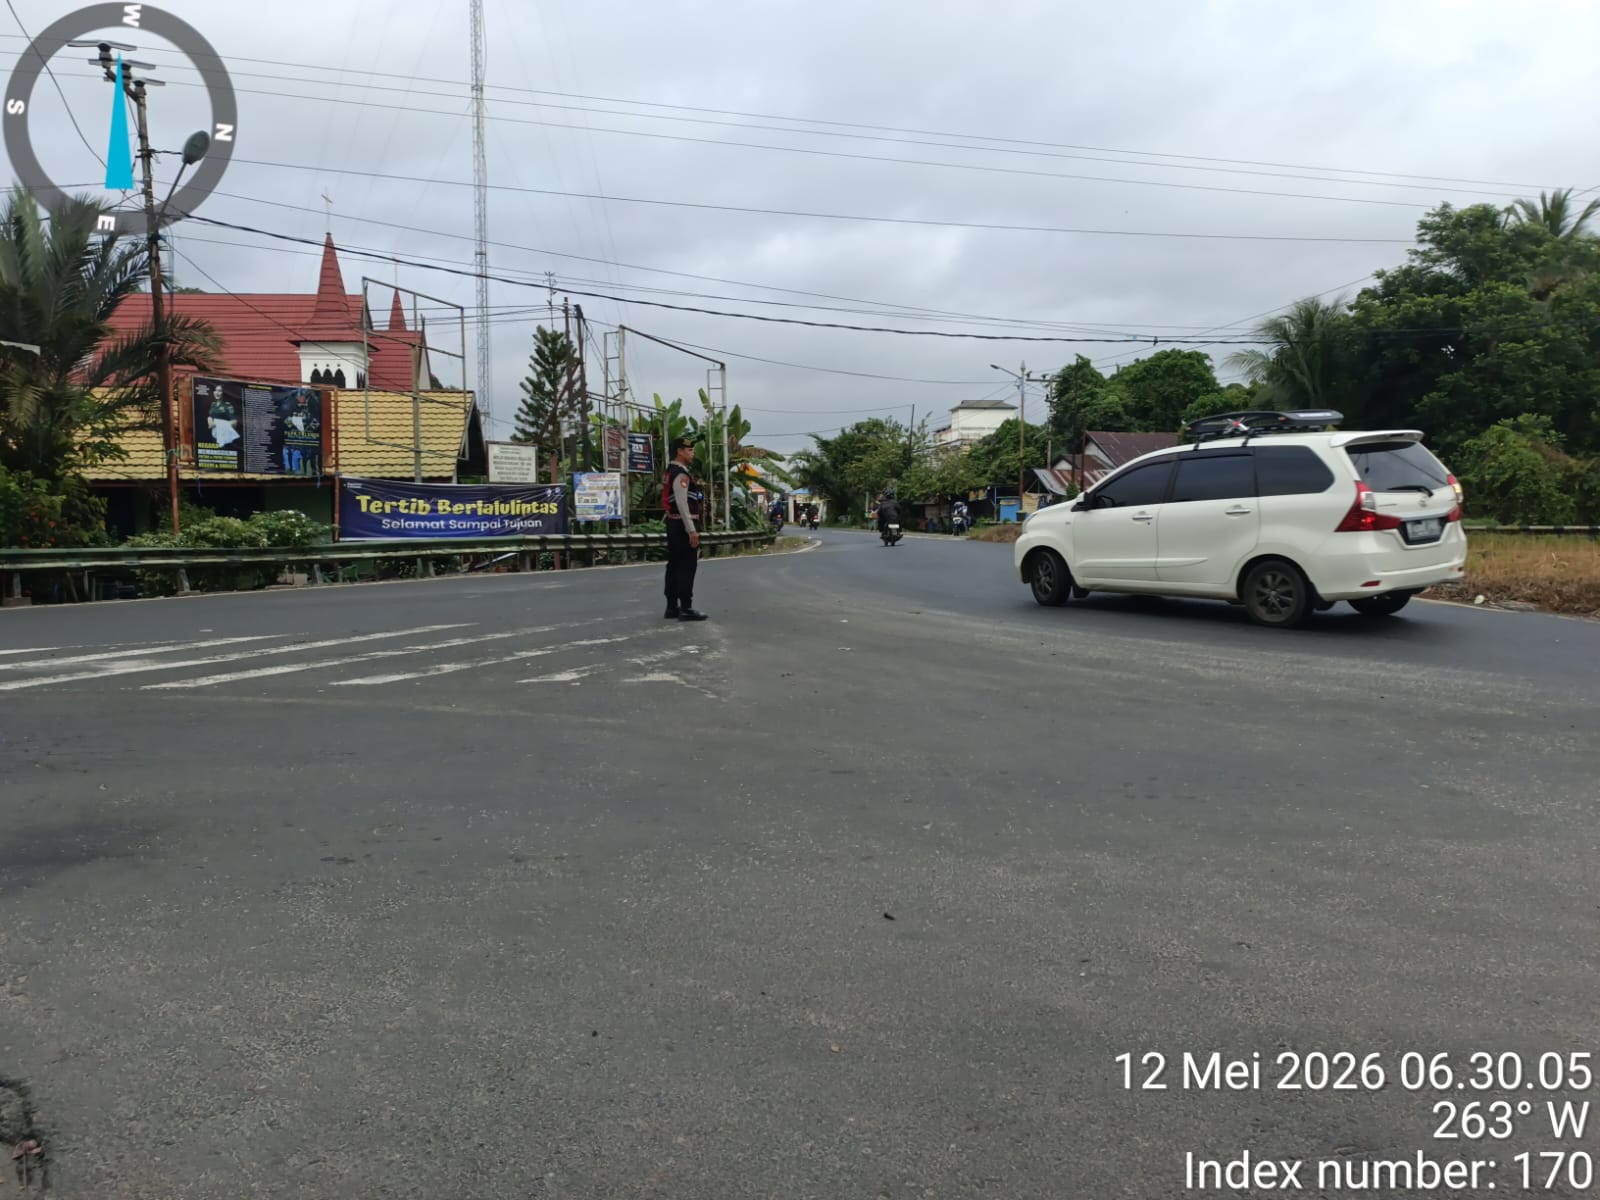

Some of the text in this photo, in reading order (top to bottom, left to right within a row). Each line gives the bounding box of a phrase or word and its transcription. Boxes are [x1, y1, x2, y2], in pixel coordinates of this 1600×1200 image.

[355, 495, 431, 515] Tertib
[437, 499, 559, 516] Berlalulintas
[381, 518, 543, 532] Selamat Sampai Tujuan
